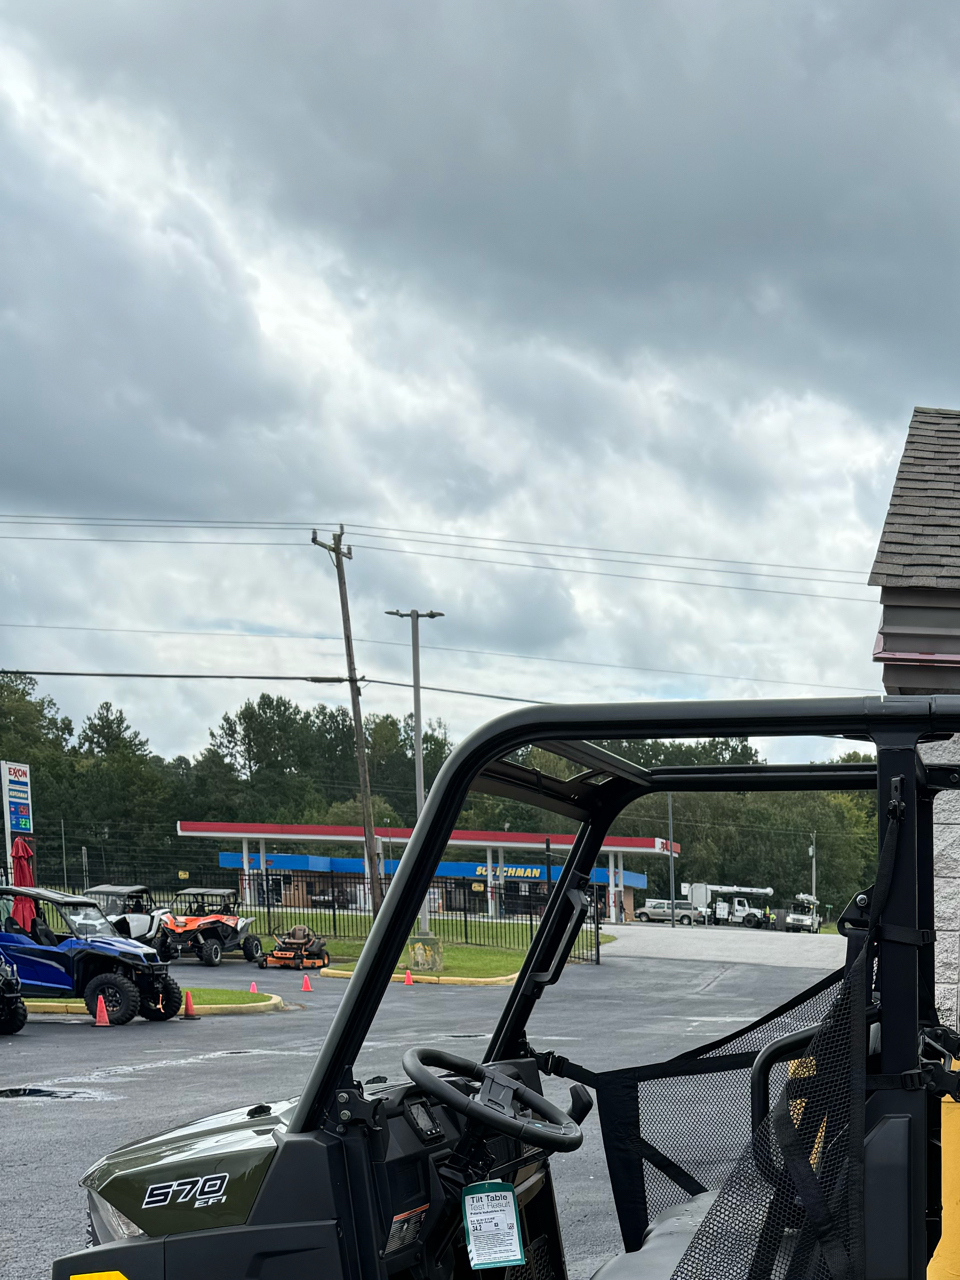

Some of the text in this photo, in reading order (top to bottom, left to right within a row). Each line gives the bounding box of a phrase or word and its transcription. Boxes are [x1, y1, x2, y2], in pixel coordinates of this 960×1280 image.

[8, 767, 28, 780] EXXON
[141, 1172, 230, 1209] 570
[193, 1195, 227, 1209] EFI
[469, 1201, 511, 1211] Test Result
[470, 1196, 483, 1204] Tilt
